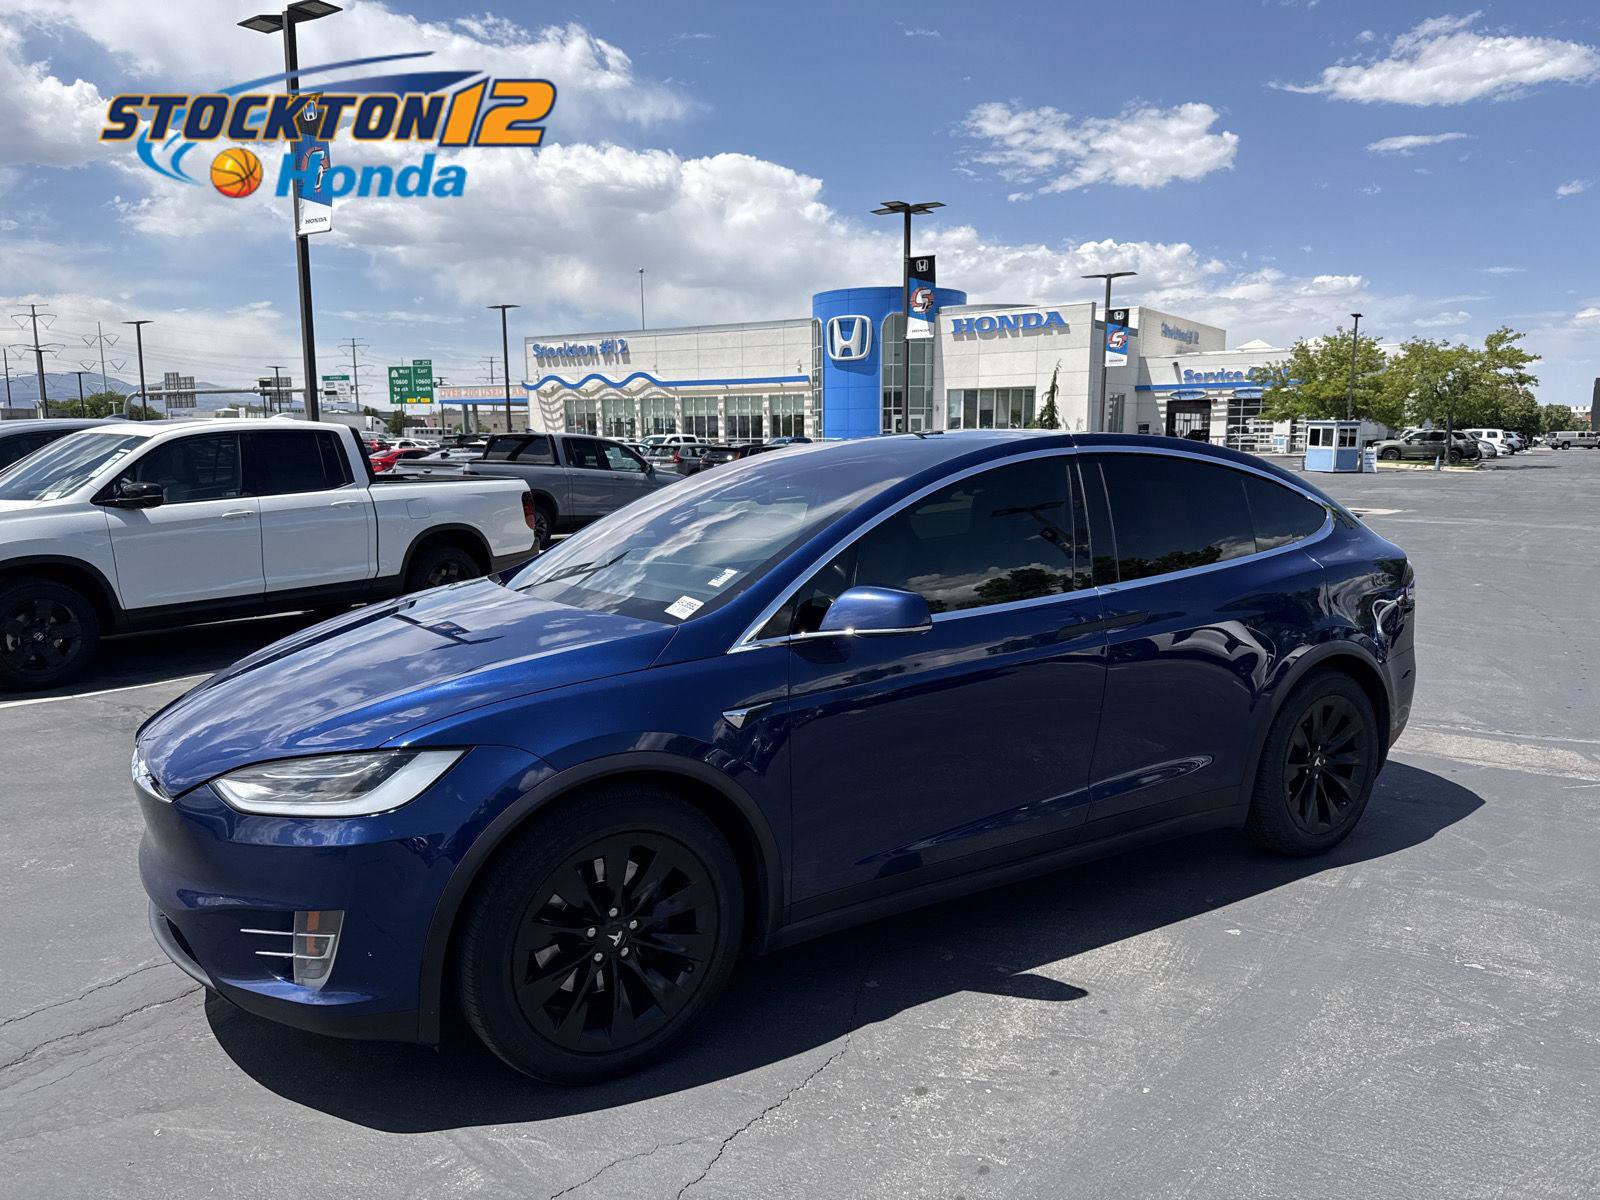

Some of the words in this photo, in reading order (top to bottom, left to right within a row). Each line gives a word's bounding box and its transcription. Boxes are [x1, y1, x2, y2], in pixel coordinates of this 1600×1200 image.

[304, 216, 328, 226] HONDA
[951, 311, 1067, 336] HONDA
[532, 342, 596, 359] Stockton
[599, 338, 627, 355] #12
[1183, 367, 1243, 383] Service
[440, 388, 462, 398] OVER
